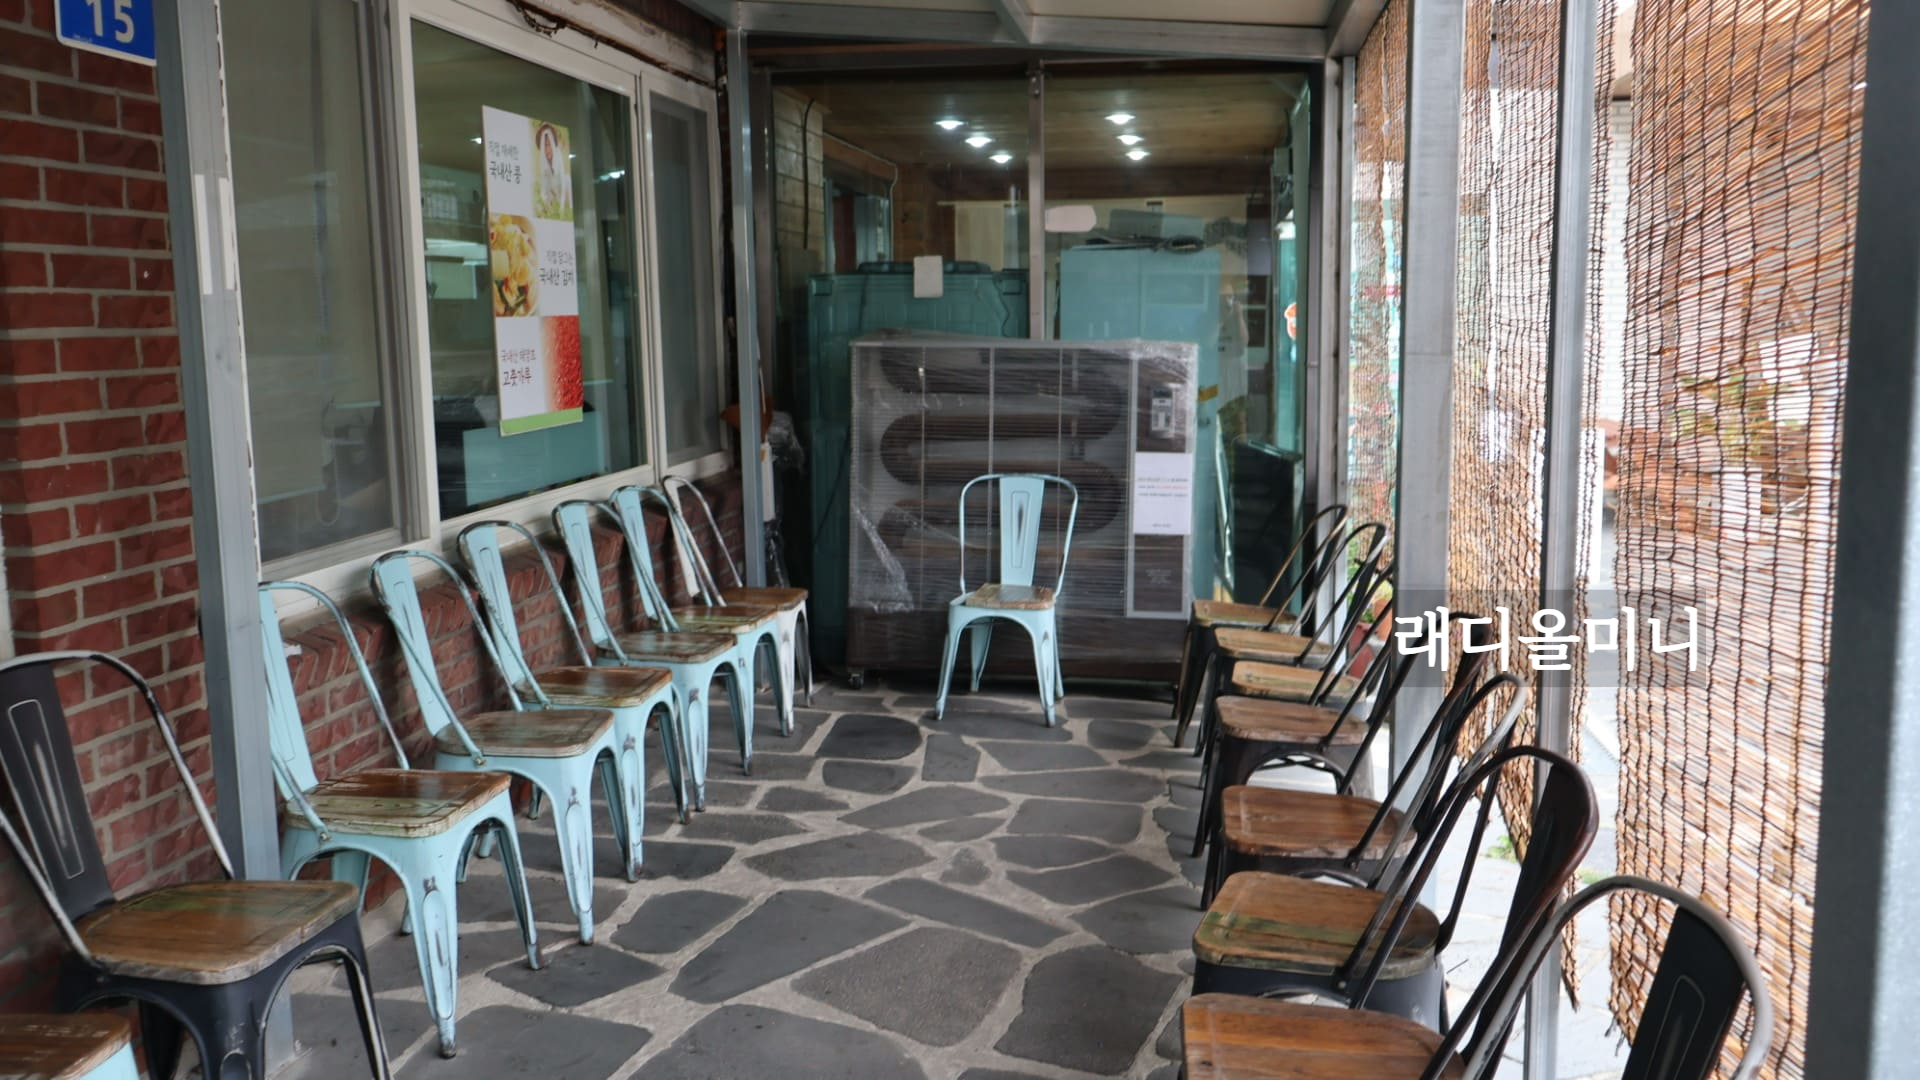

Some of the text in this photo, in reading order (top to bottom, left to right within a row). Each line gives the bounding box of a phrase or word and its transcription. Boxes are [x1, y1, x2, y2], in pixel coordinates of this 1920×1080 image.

[85, 0, 134, 44] 15
[489, 160, 522, 185] 국내산 콩
[539, 267, 574, 287] 국내산 김치
[503, 366, 532, 387] 고춧가루
